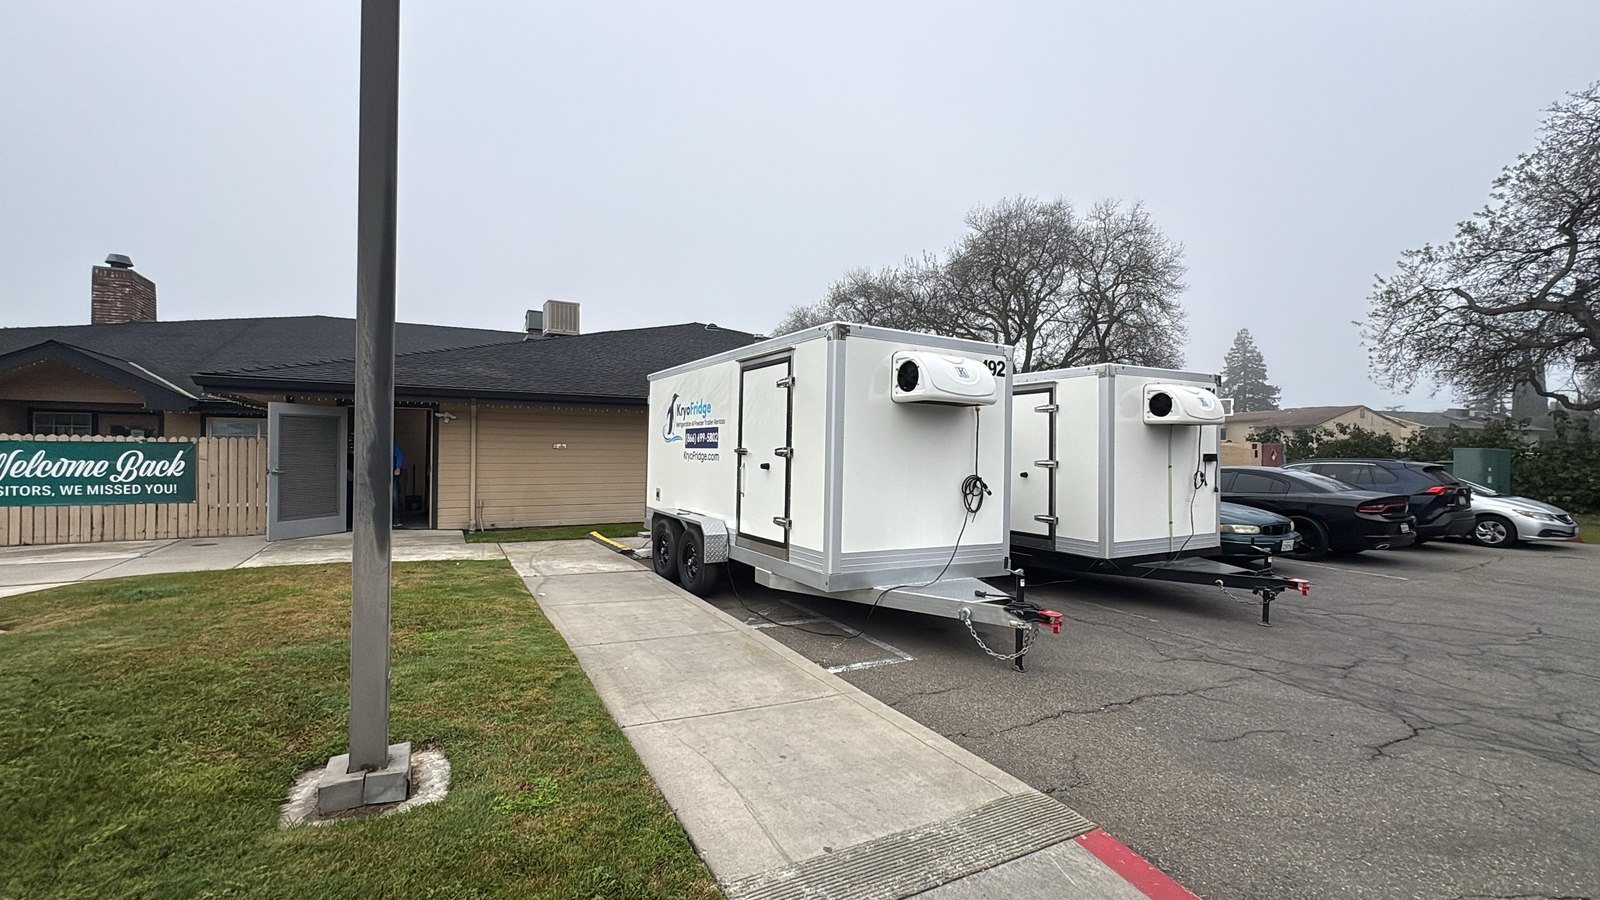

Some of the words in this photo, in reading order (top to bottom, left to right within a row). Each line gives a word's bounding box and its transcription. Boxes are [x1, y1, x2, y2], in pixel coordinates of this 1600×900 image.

[676, 398, 712, 420] KryoFridge
[683, 450, 720, 463] KryoFridge.com
[109, 450, 186, 483] Back
[60, 485, 83, 496] WE
[87, 484, 142, 496] MISSED
[145, 484, 178, 495] YOU!
